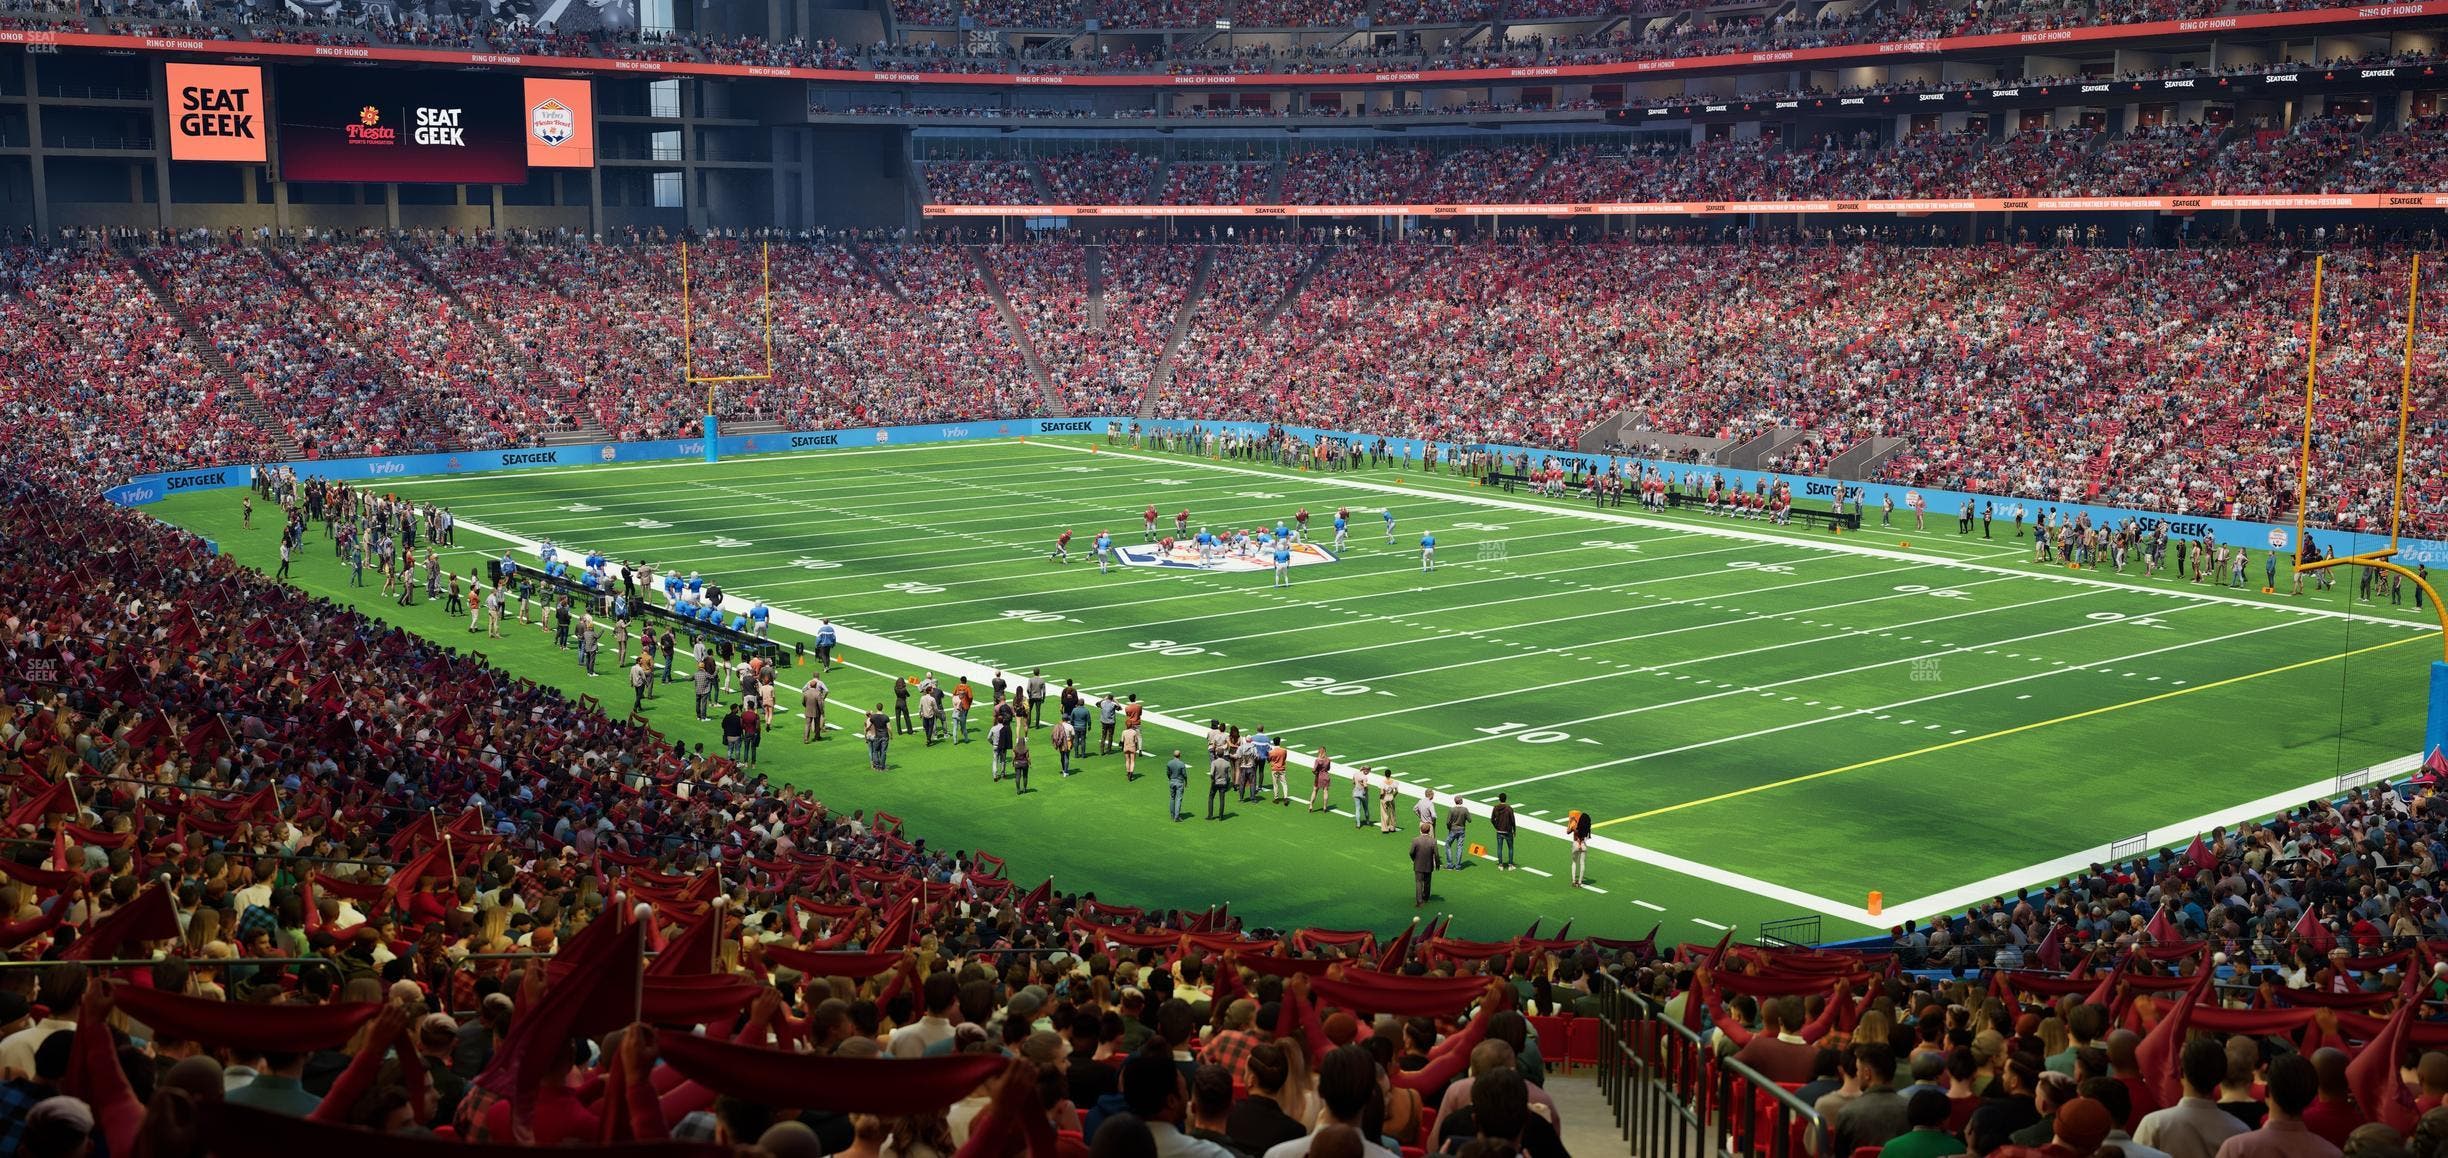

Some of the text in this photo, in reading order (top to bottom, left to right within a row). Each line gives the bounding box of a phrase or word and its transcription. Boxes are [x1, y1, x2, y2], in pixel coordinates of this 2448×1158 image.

[2359, 5, 2422, 17] RING OF HONOR
[2180, 21, 2197, 30] RING
[2209, 19, 2236, 27] HONOR
[2021, 33, 2037, 41] RING
[2048, 31, 2071, 39] HONOR
[146, 39, 164, 47] RING
[2265, 74, 2298, 82] SEATGEEK
[2361, 68, 2395, 78] SEATGEEK
[2081, 84, 2109, 92] SEATGEEK
[2164, 79, 2194, 88] SEATGEEK
[182, 86, 249, 112] SEAT
[1992, 89, 2018, 97] SEATGEEK
[416, 107, 462, 126] SEAT
[180, 113, 255, 138] GEEK
[346, 124, 396, 139] Fiesta
[415, 127, 465, 146] GEEK
[2172, 199, 2200, 207] SEATGEEK
[2390, 196, 2422, 205] SEATGEEK
[942, 426, 968, 438] Vrbo
[1041, 421, 1092, 432] SEATGEEK
[791, 434, 838, 447] SEATGEEK
[502, 451, 556, 465] SEATGEEK
[369, 461, 404, 474] Vrbo
[167, 472, 226, 490] SEATGEEK
[121, 487, 153, 502] Vrbo
[883, 581, 946, 594] 50
[999, 609, 1066, 623] 40
[1127, 639, 1206, 656] 30
[1281, 676, 1372, 696] 20
[1474, 722, 1571, 744] 10
